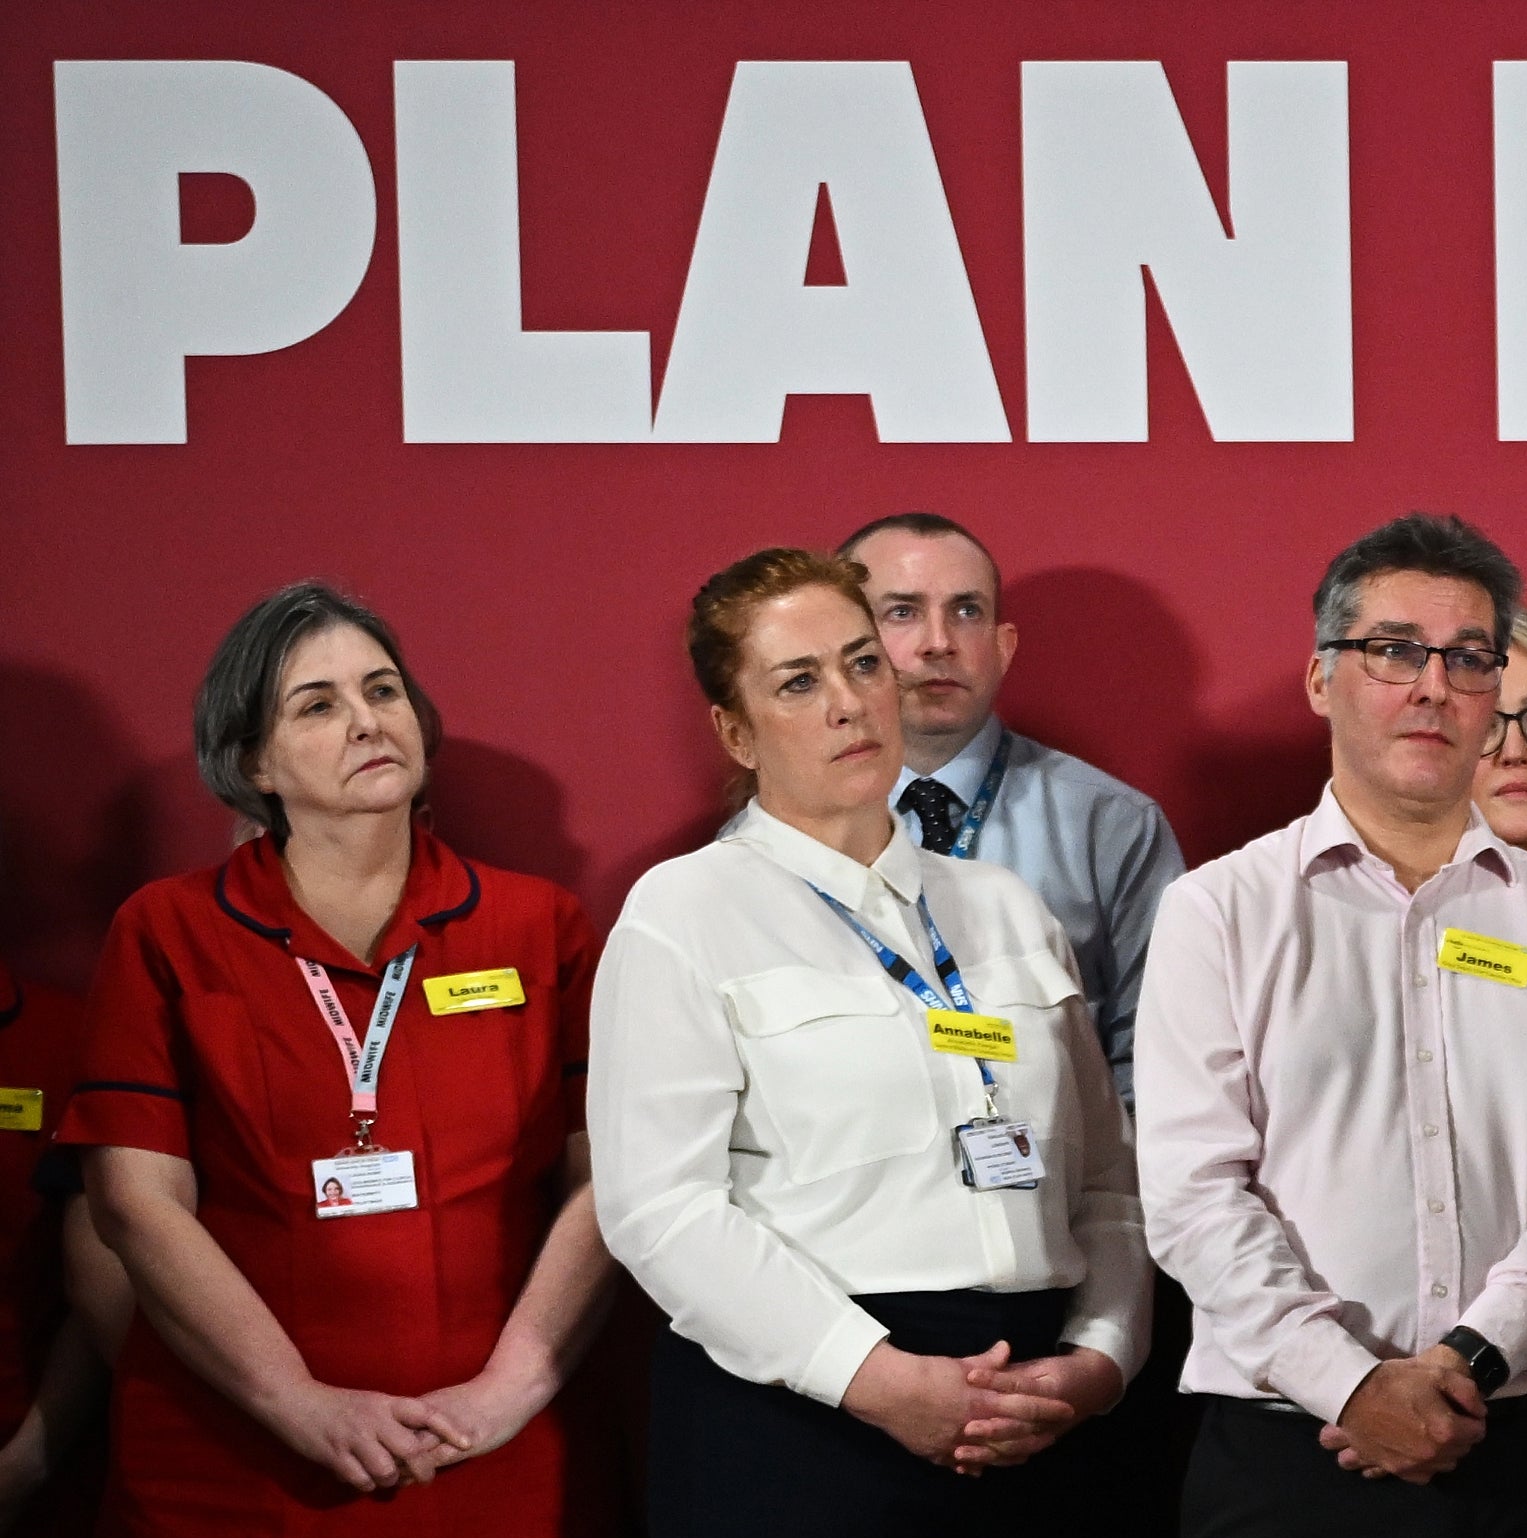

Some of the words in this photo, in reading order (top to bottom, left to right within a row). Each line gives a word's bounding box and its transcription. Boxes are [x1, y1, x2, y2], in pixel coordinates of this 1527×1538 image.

[54, 60, 1355, 445] PLAN
[1455, 952, 1513, 974] James
[448, 984, 499, 997] Laura
[950, 983, 968, 1007] NHS
[319, 988, 344, 1026] MIDWIFE
[376, 990, 396, 1028] MIDWIFE
[933, 1023, 1012, 1044] Annabelle
[360, 1041, 381, 1083] MIDWIFE
